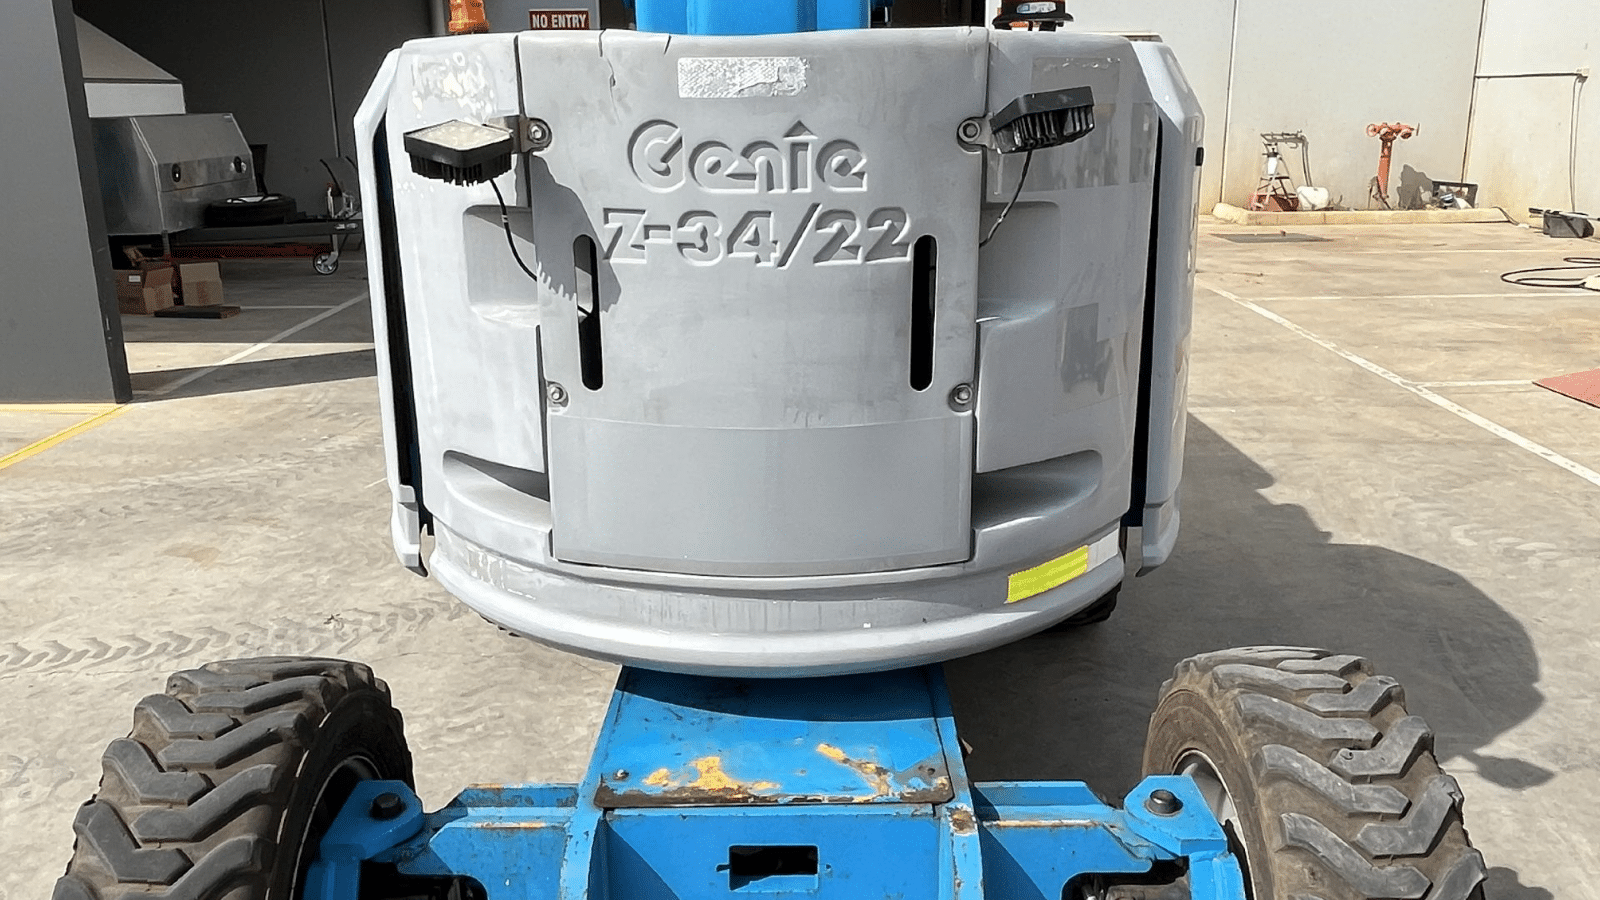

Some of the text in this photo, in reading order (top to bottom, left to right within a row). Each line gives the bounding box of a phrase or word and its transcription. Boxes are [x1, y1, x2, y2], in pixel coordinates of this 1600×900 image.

[532, 14, 587, 28] NO ENTRY
[627, 119, 868, 193] Genie
[602, 202, 912, 270] Z-34/22
